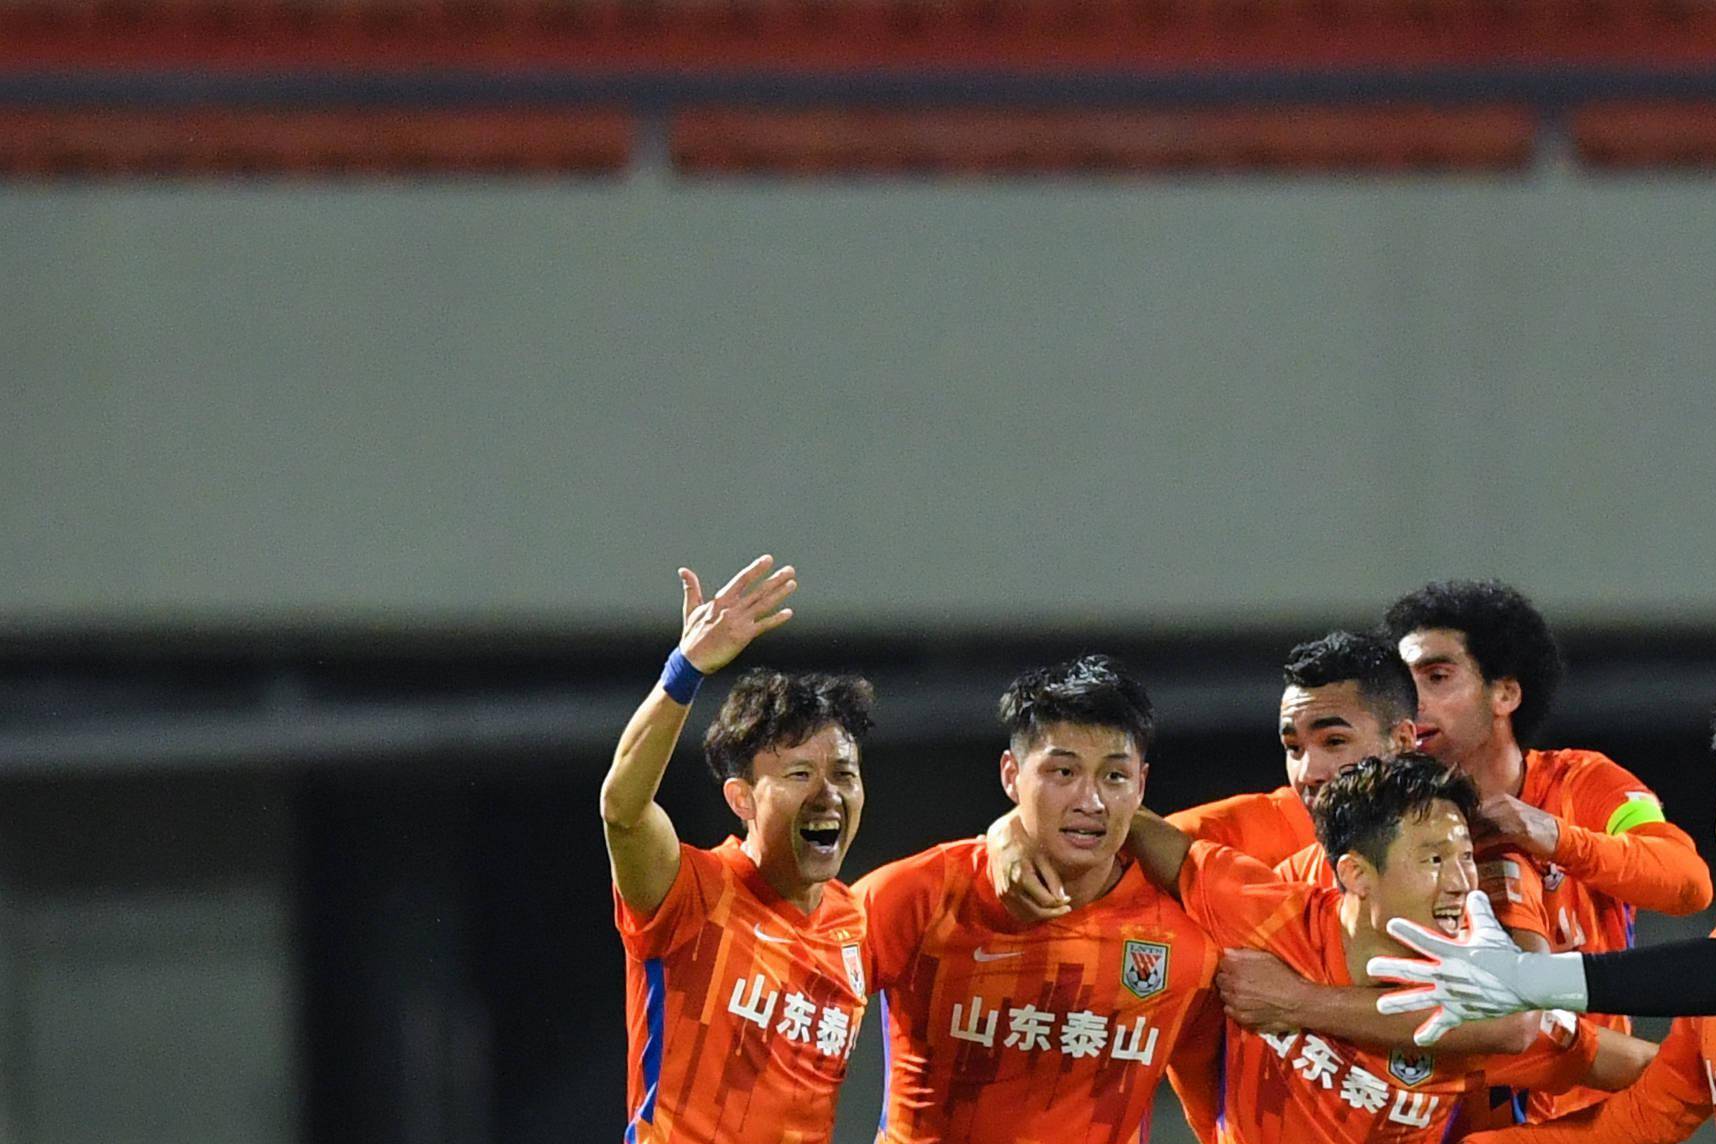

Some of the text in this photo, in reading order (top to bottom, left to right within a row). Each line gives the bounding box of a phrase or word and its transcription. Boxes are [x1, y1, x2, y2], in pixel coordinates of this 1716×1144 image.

[728, 973, 857, 1059] 山东泰
[949, 996, 1160, 1065] 山东泰山
